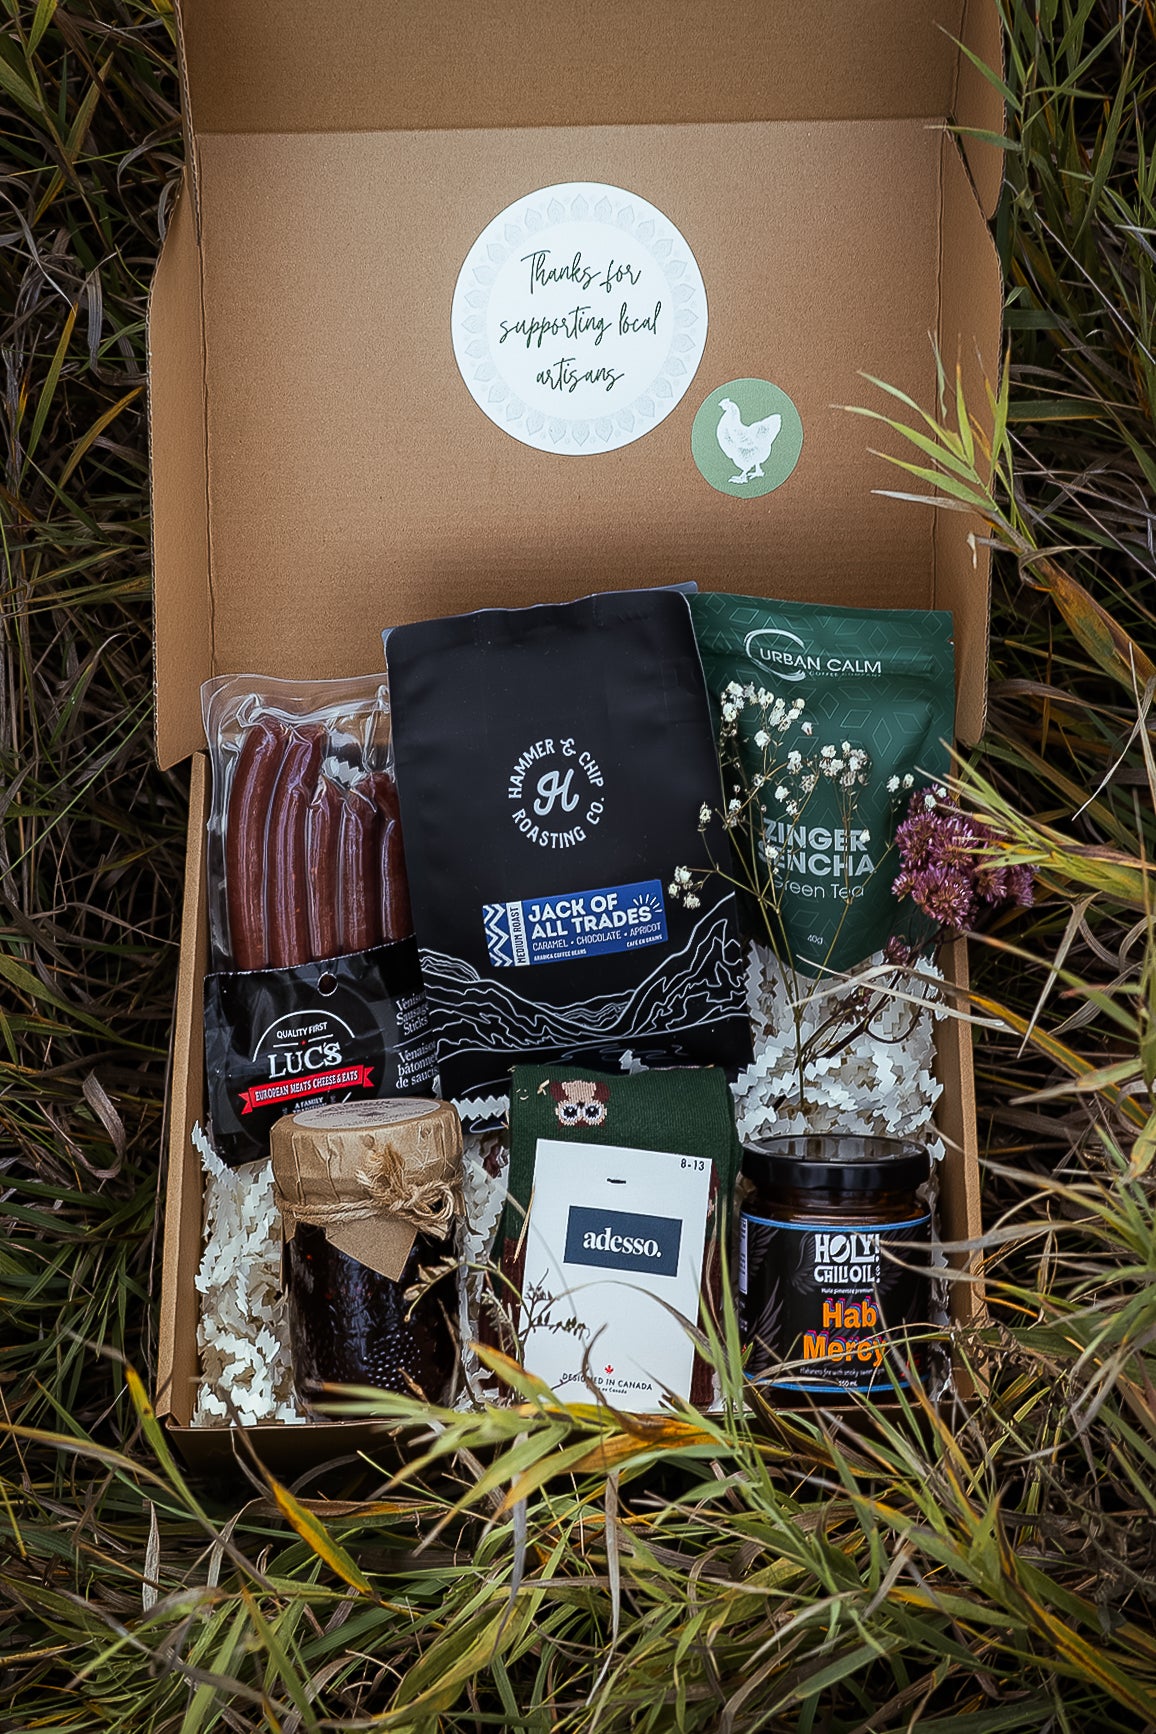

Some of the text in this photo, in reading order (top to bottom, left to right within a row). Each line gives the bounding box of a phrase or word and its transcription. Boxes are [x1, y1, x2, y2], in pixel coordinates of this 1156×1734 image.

[521, 250, 641, 294] Thanks for
[499, 301, 662, 348] supporting local
[536, 357, 625, 393] artisans
[760, 648, 881, 673] URBAN CALM
[508, 738, 604, 799] HAMMER & CHIP
[512, 808, 587, 849] ROASTING
[763, 818, 868, 852] ZINGER
[830, 883, 864, 899] Tea
[528, 893, 618, 923] JACK OF
[531, 905, 652, 940] ALL TRADES
[513, 906, 526, 964] MEDIUM ROAST
[532, 922, 662, 952] CARAMEL CHOCOLATE APRICOT
[277, 1022, 328, 1039] QUALITY FIRST
[403, 1016, 428, 1036] Sticks
[255, 1086, 289, 1101] EUROPEAN
[290, 1080, 312, 1093] MEATS
[312, 1076, 337, 1088] CHEESE
[342, 1071, 358, 1082] EATS
[395, 1077, 409, 1089] de
[680, 1158, 705, 1171] 8-13
[583, 1227, 662, 1258] adesso.
[822, 1296, 880, 1329] Hab
[803, 1330, 887, 1367] Mercy
[562, 1373, 653, 1391] DESIGED IN CANADA
